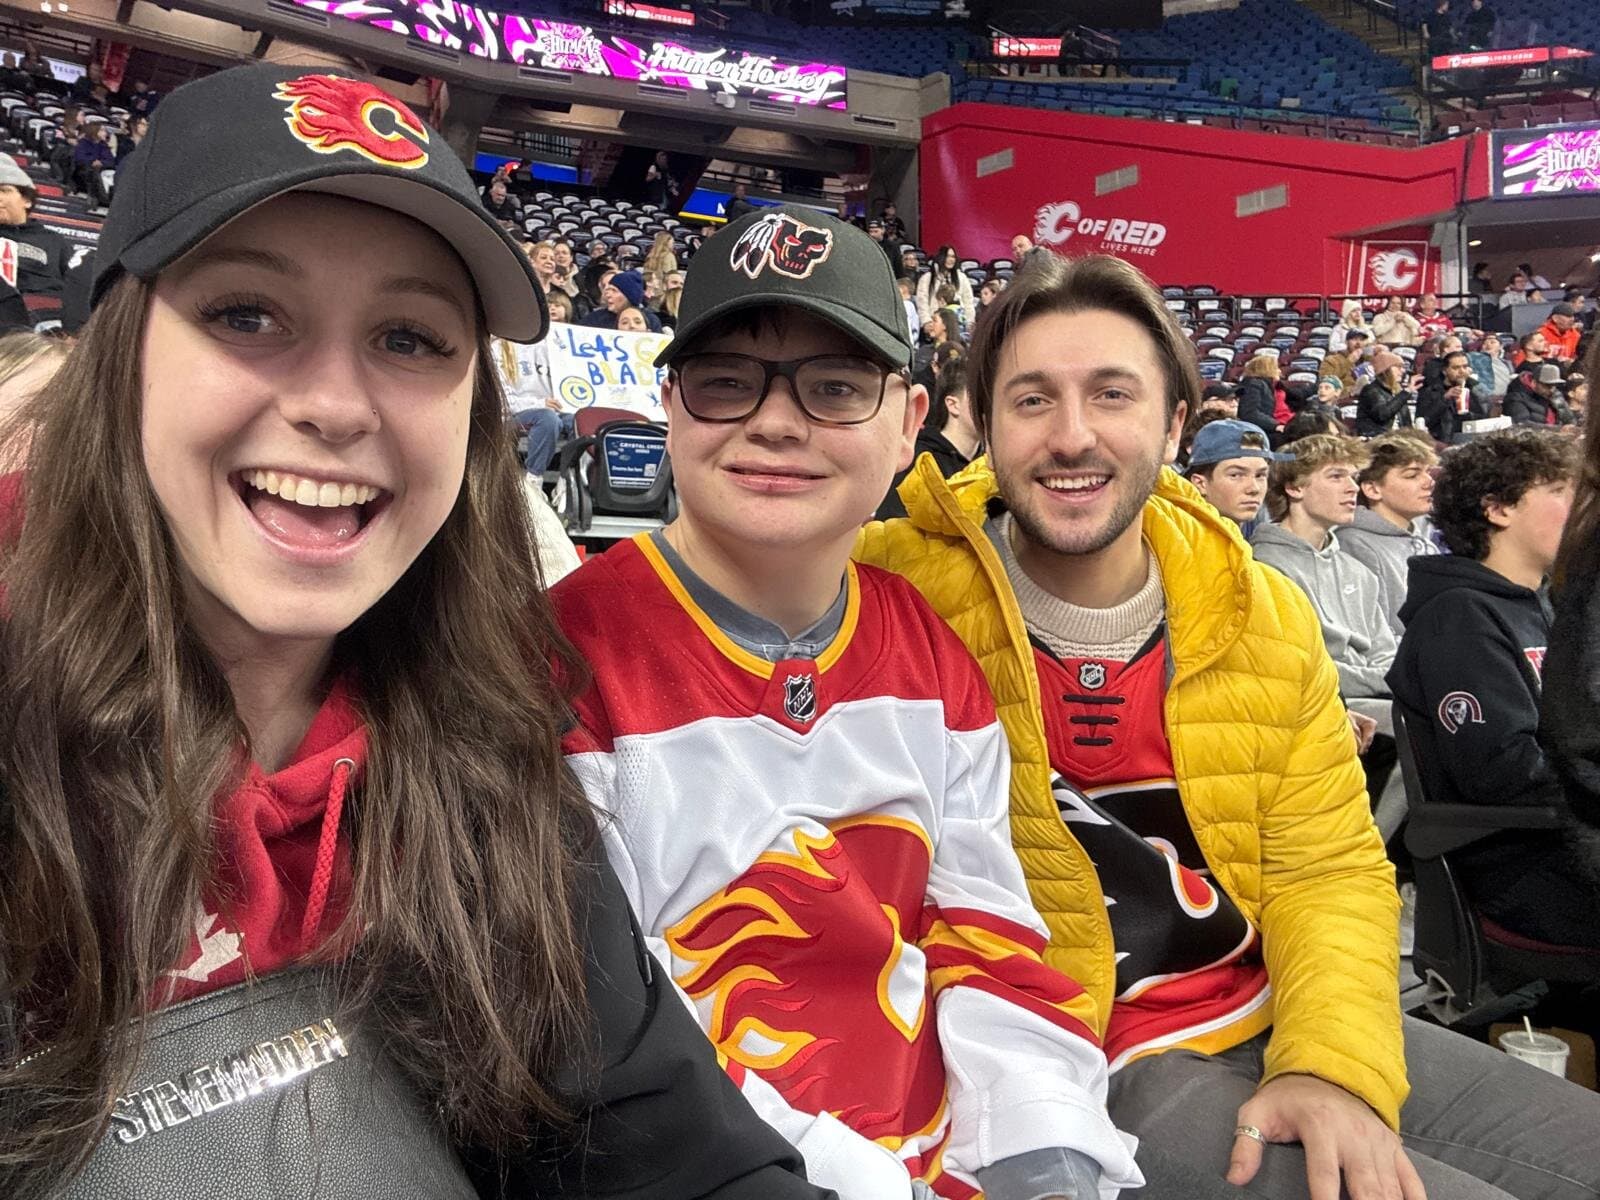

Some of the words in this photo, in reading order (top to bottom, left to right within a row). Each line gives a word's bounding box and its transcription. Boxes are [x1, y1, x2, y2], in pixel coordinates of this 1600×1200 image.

[649, 42, 741, 80] Hitmen
[736, 56, 840, 103] Hockey
[1077, 218, 1108, 235] OF
[1104, 218, 1167, 247] RED
[1101, 241, 1128, 252] LIVES
[1130, 246, 1157, 256] HERE
